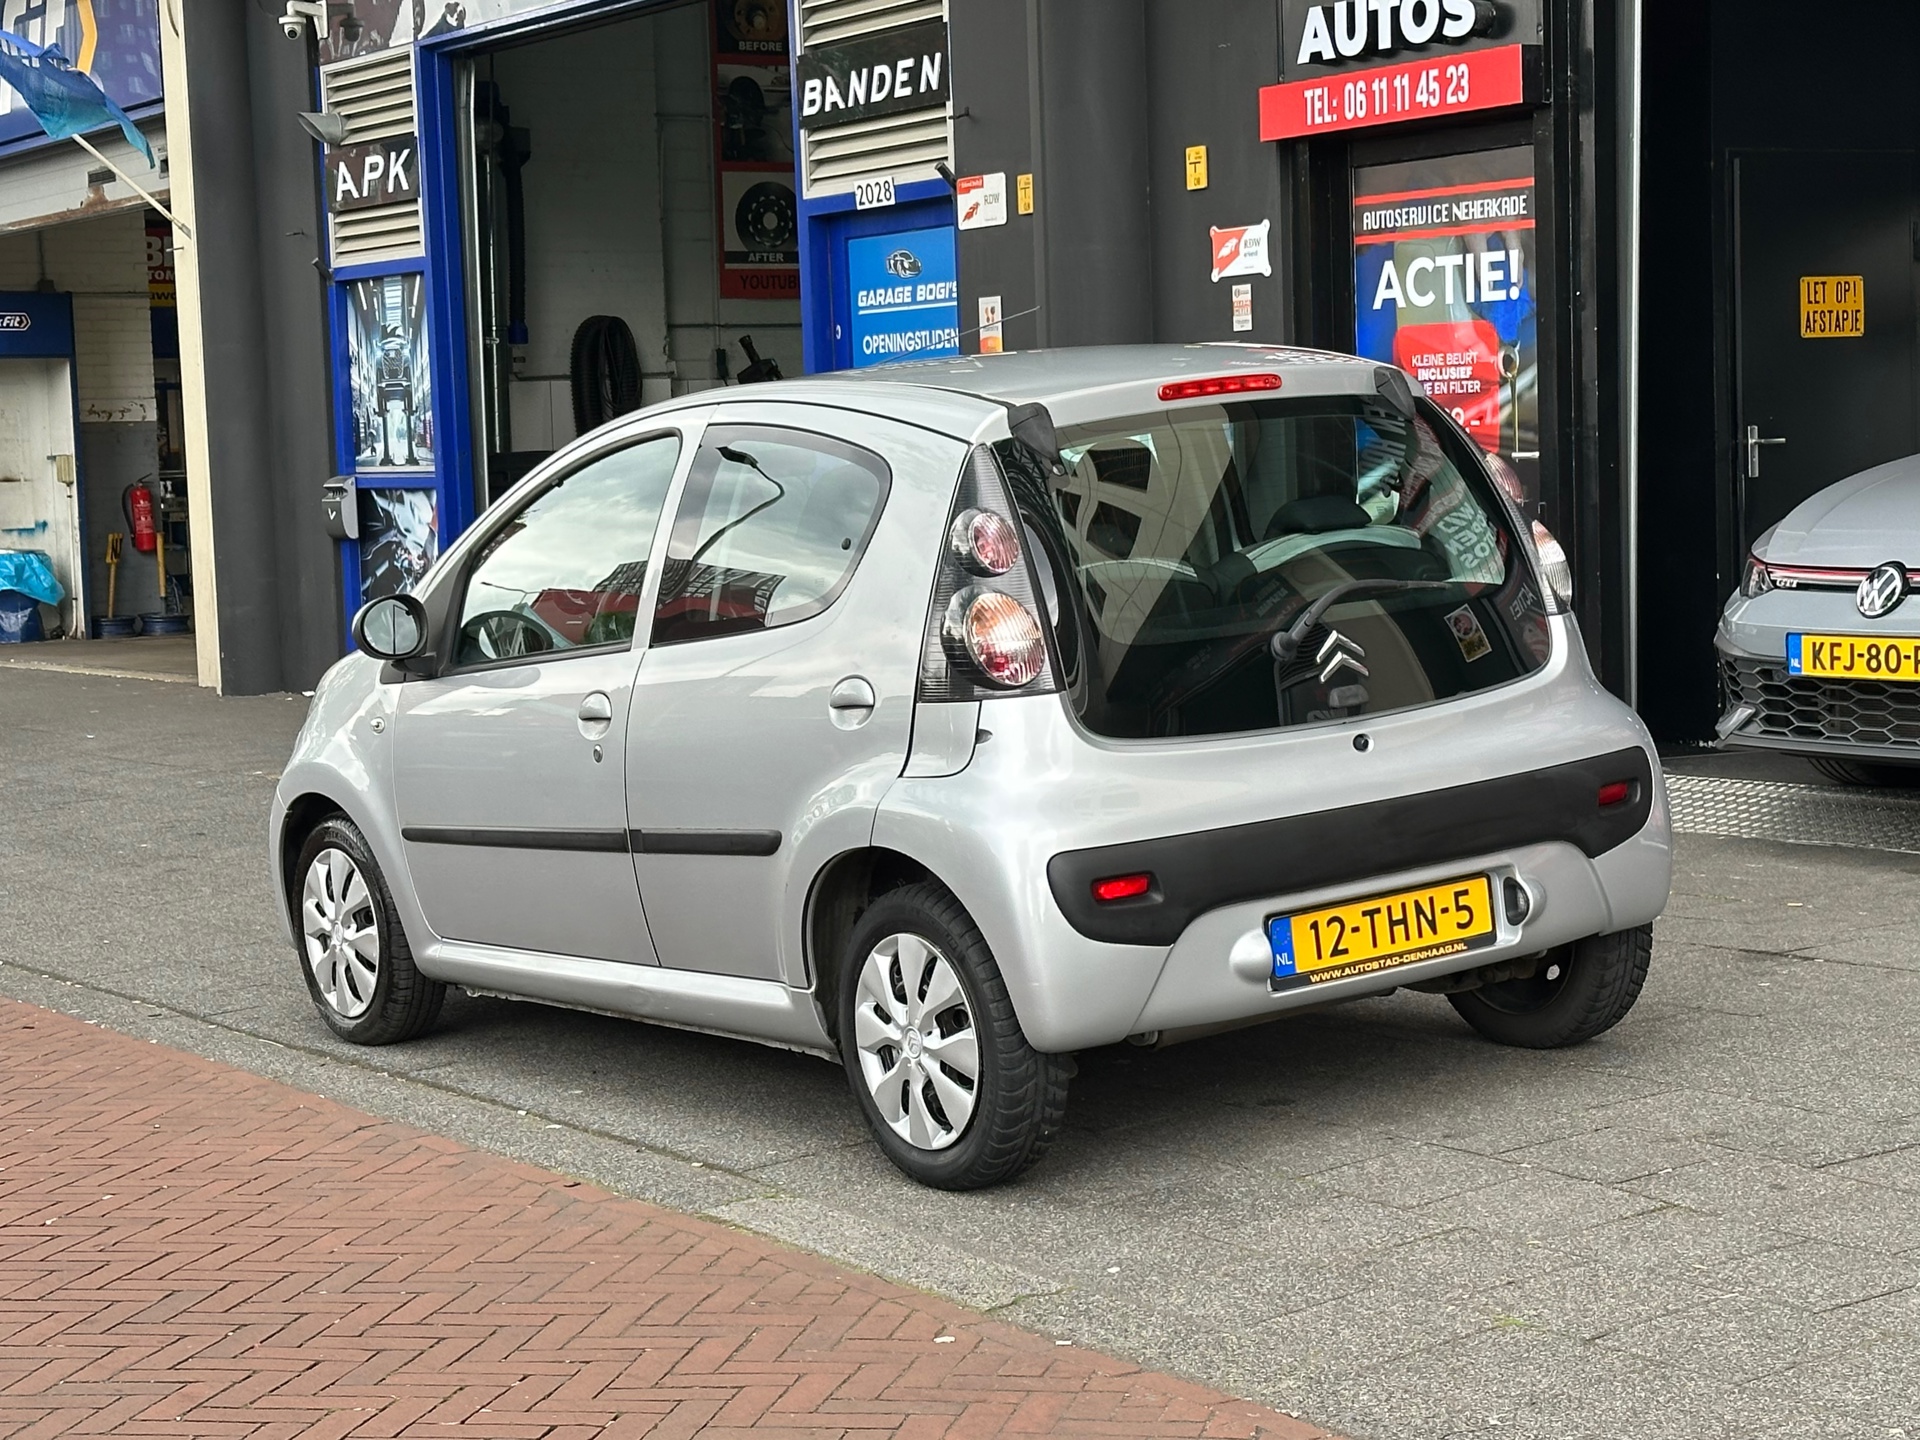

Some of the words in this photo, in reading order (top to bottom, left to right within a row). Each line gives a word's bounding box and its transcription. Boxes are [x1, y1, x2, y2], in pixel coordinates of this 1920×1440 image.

[1297, 0, 1476, 65] AUTOS
[738, 41, 783, 52] BEFORE
[802, 52, 942, 117] BANDEN
[1303, 86, 1338, 126] TEL:
[1344, 80, 1367, 120] 06
[1371, 77, 1388, 115] 11
[1393, 73, 1410, 112] 11
[1415, 68, 1440, 108] 45
[1446, 63, 1469, 105] 23
[336, 148, 411, 202] APK
[856, 180, 892, 207] 2028
[1452, 195, 1528, 222] NEHERKADE
[748, 252, 785, 262] AFTER
[1372, 249, 1520, 310] ACTIE!
[857, 285, 913, 308] GARAGE
[1807, 281, 1828, 305] LET
[1835, 280, 1857, 304] OP!
[1805, 308, 1861, 333] AFSTAPJE
[862, 327, 959, 355] OPENINGSTIJDEN
[1411, 353, 1444, 367] KLEINE
[1446, 350, 1478, 365] BEURT
[1417, 366, 1473, 381] INCLUSIEF
[1434, 381, 1448, 395] EN
[1449, 380, 1481, 394] FILTER
[1775, 579, 1799, 589] GTI
[1791, 658, 1801, 668] NL
[1309, 888, 1475, 960] 12-THN-5
[1276, 953, 1293, 966] NL
[1309, 942, 1468, 984] WWW.AUTOSTAD-DENHAAG.NL
